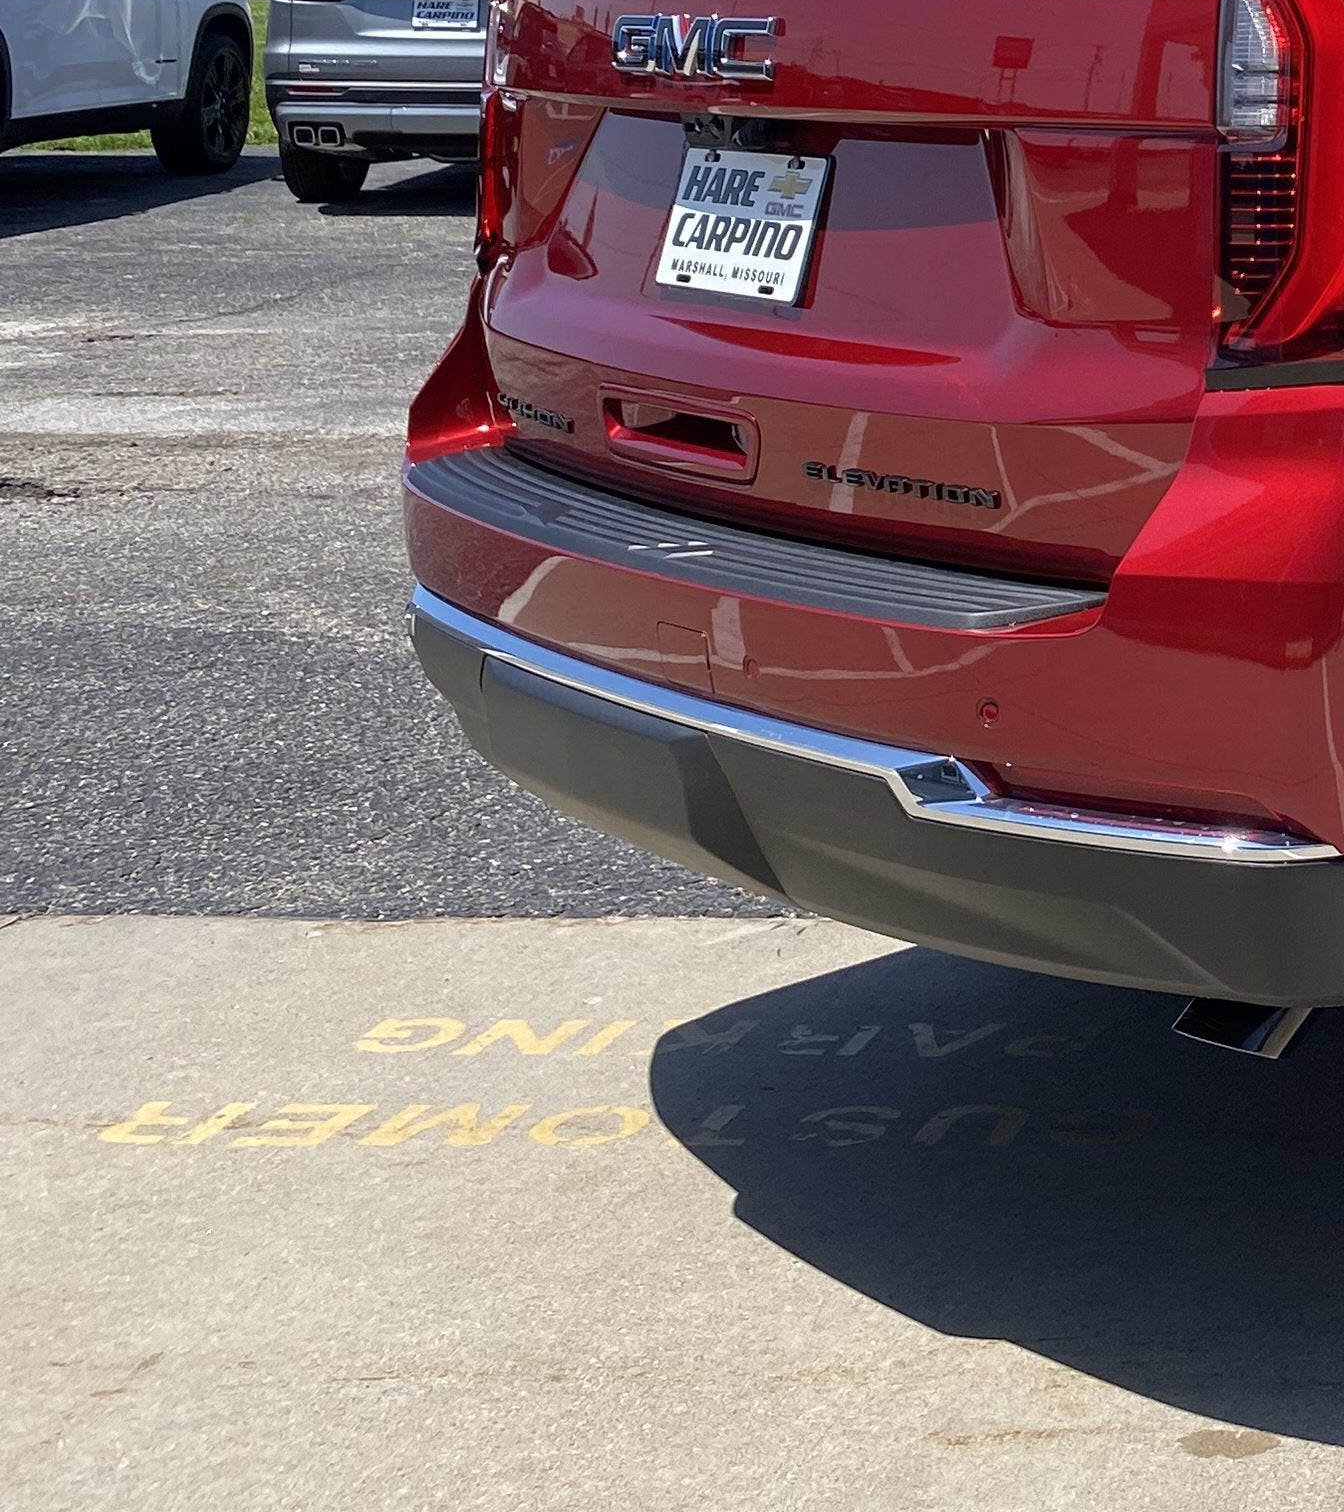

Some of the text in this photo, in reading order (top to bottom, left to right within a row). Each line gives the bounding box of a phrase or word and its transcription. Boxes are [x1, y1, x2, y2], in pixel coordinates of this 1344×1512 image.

[611, 13, 780, 81] GMC
[682, 165, 765, 207] HARE
[764, 201, 804, 218] GMC
[671, 212, 803, 261] CARPINO
[671, 257, 785, 286] MARSHALL, MISSOURI
[802, 460, 1001, 510] ELEVATION
